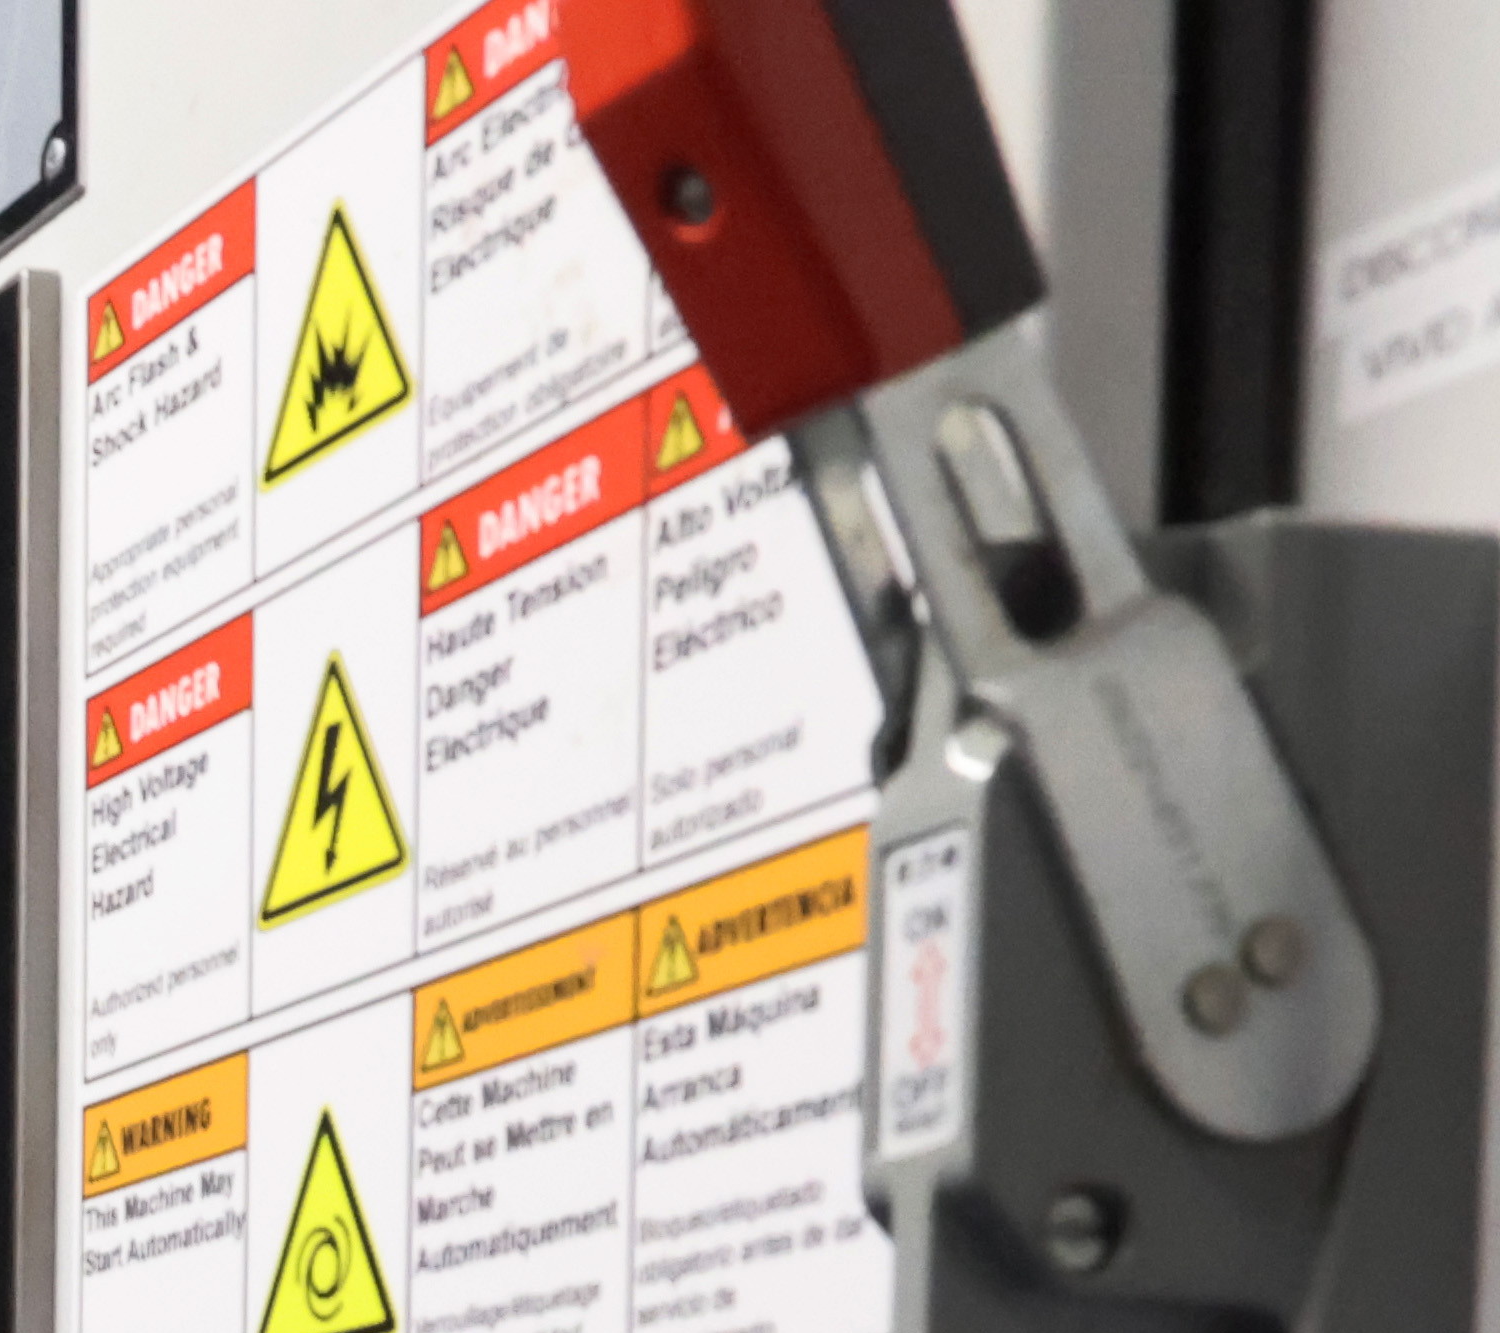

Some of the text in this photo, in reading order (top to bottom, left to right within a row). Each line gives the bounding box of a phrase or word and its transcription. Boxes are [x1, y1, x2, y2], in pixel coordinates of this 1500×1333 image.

[131, 226, 223, 334] DANGER
[92, 323, 198, 421] Arc Flash &
[92, 354, 222, 468] Shock Hazard
[477, 449, 601, 563] DANGER
[426, 544, 608, 666] Haute Tension
[654, 527, 759, 623] Peligro
[130, 656, 220, 745] DANGER
[425, 646, 513, 730] Danger
[92, 744, 208, 835] High Voltage
[92, 808, 176, 874] Electrical
[92, 867, 154, 921] Hazard
[90, 1030, 115, 1063] only
[643, 1014, 696, 1063] Esta
[418, 1052, 576, 1131] Cette Machine
[643, 1057, 742, 1115] Arranca
[121, 1096, 211, 1157] WARNING
[418, 1099, 613, 1178] Peut se Mettre en
[86, 1163, 234, 1235] This Machine May
[417, 1178, 494, 1228] Marche
[85, 1204, 247, 1276] Start Automatically
[417, 1199, 616, 1283] Automatiquement
